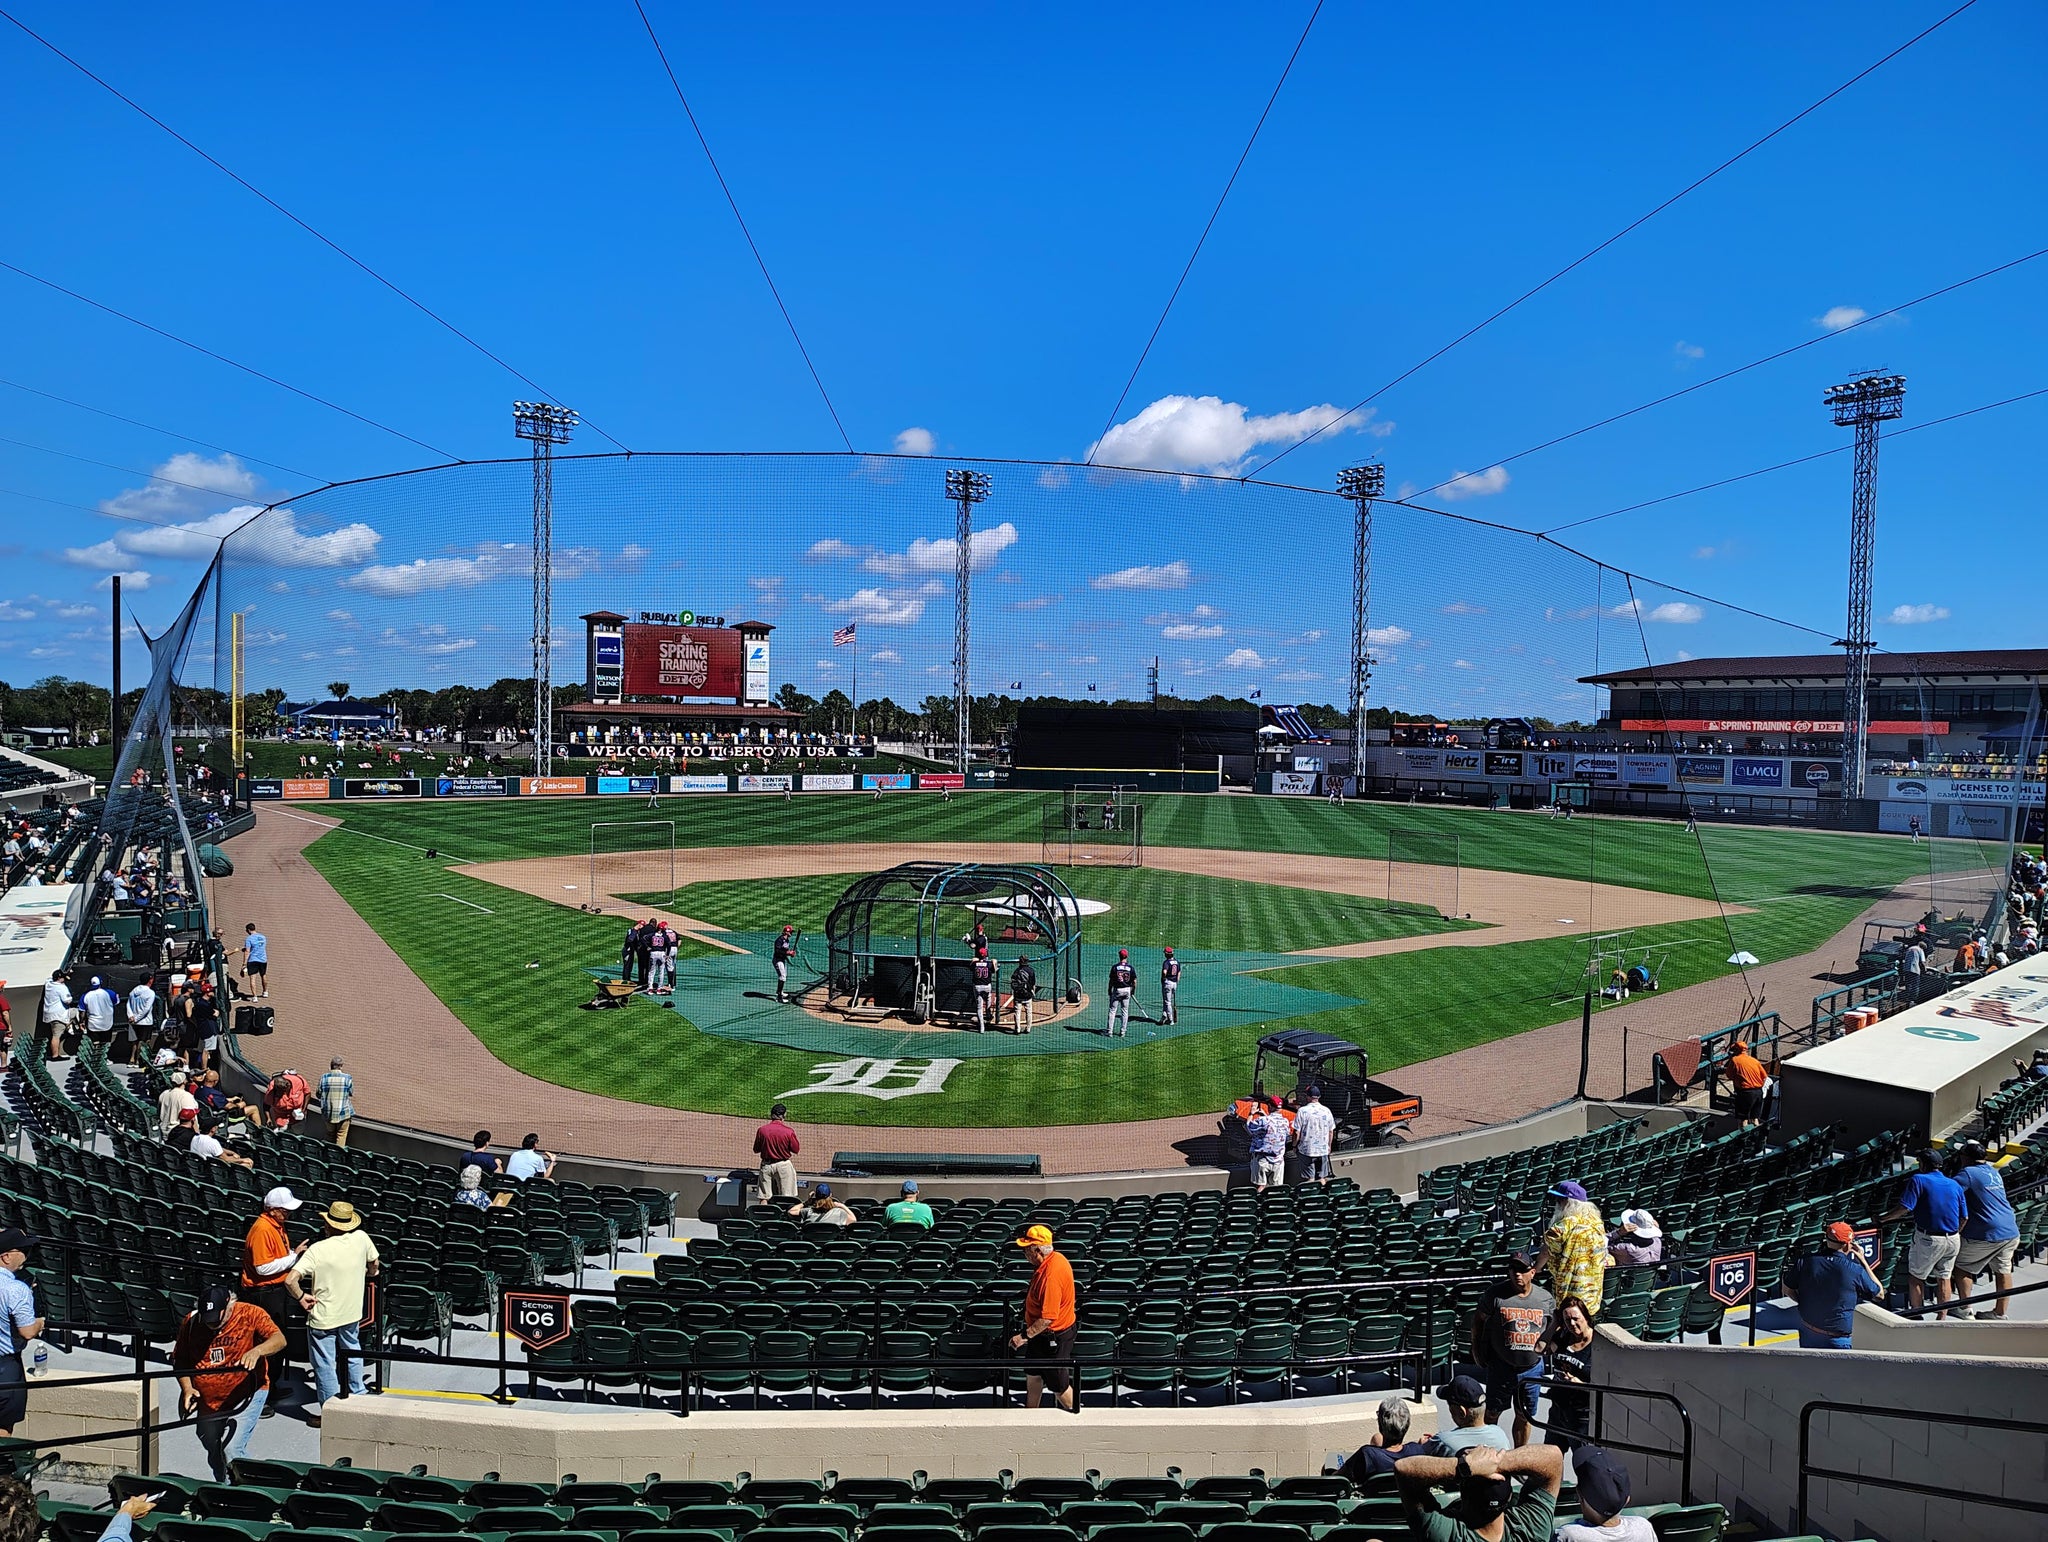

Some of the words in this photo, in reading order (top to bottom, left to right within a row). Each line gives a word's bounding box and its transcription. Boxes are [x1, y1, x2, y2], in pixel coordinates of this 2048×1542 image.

[659, 643, 708, 659] SPRING
[659, 658, 708, 671] TRAINING
[692, 674, 703, 684] 26
[1721, 721, 1751, 731] SPRING
[1752, 721, 1792, 732] TRAINING
[1818, 722, 1835, 730] DET
[586, 745, 675, 757] WELCOME
[681, 746, 703, 757] TO
[807, 746, 837, 757] USA
[1444, 754, 1480, 768] Hertz
[1537, 757, 1566, 777] Lite
[1694, 763, 1721, 771] AGNINI
[1746, 766, 1779, 777] LMCU
[815, 777, 847, 785] CREWS
[1951, 783, 1993, 793] LICENSE
[1994, 785, 2009, 793] TO
[1721, 1261, 1745, 1271] SECTION
[1719, 1269, 1745, 1286] 106
[522, 1301, 554, 1310] SECTION
[520, 1310, 555, 1327] 106
[1500, 1307, 1544, 1328] DETROIT
